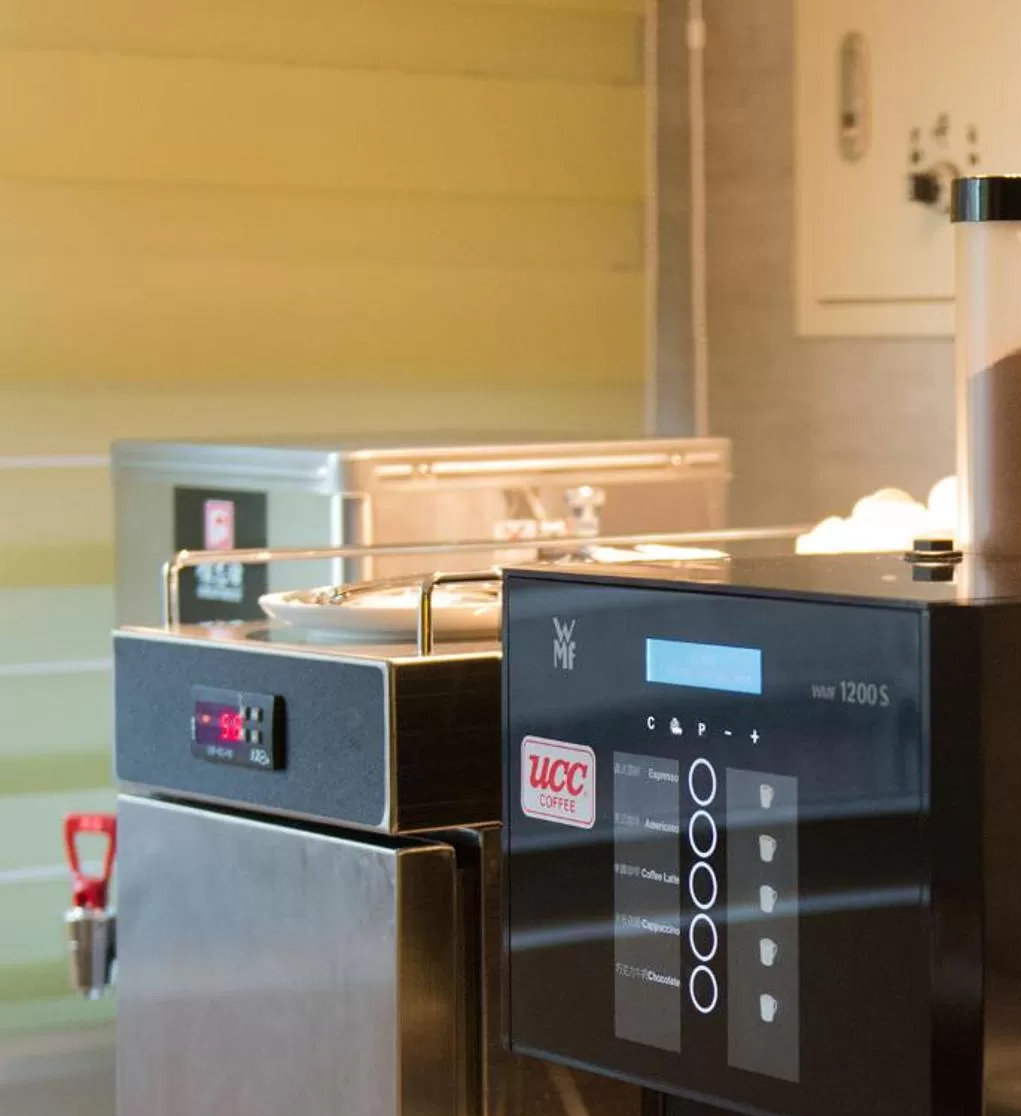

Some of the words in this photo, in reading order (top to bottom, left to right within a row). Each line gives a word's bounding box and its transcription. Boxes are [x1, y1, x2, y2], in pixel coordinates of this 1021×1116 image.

[646, 716, 656, 730] C
[697, 722, 706, 736] P
[529, 754, 588, 797] UCC
[648, 767, 679, 783] Espresso
[540, 793, 575, 813] COFFEE
[644, 817, 679, 834] Americano
[641, 868, 662, 882] Coffee
[647, 970, 680, 987] Chocolate
